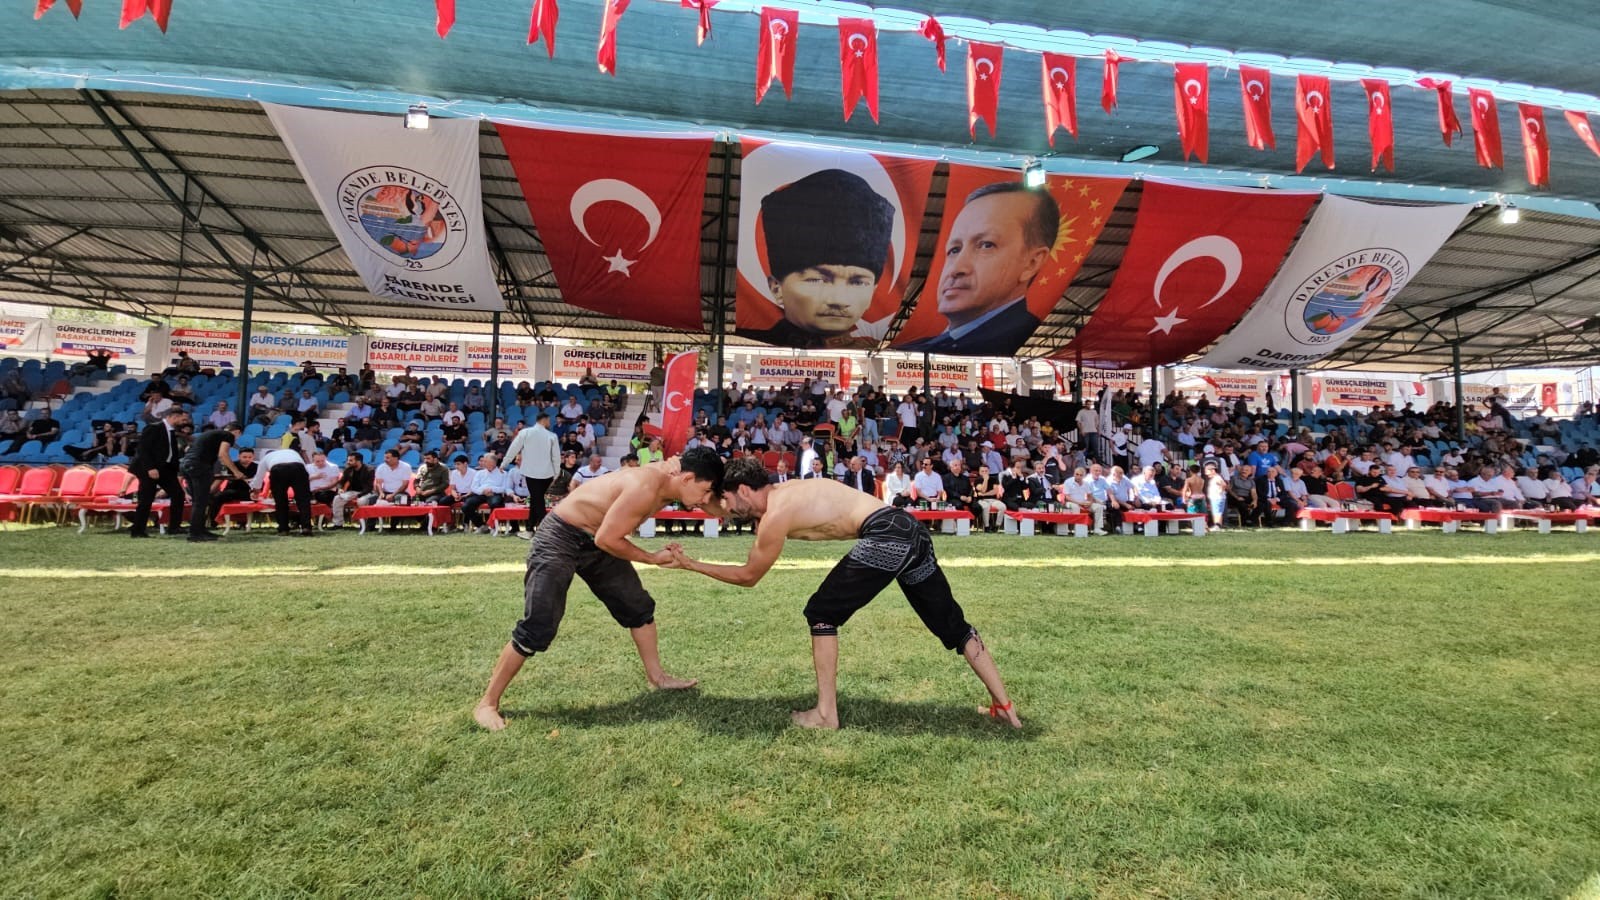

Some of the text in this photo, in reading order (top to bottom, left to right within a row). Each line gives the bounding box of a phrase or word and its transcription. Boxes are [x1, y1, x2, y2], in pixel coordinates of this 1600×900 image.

[342, 170, 465, 233] DARENDE BELEDYESİ
[1295, 253, 1368, 303] DARENDE
[384, 283, 476, 304] ELEDİYESİ
[169, 347, 210, 356] BAARILAR
[370, 340, 459, 353] GÜREŞÇİLERİMİZE
[369, 351, 459, 363] BAŞARILAR DİLERİZ
[563, 349, 648, 362] GÜREŞÇİLERİMİZE
[563, 359, 647, 371] BAŞARILAR DİLERİZ
[760, 357, 836, 369] GÜREŞÇİLERİMİZE
[760, 367, 836, 378] BAŞARILAR DİLRİZ
[941, 372, 969, 381] DİLERİZ
